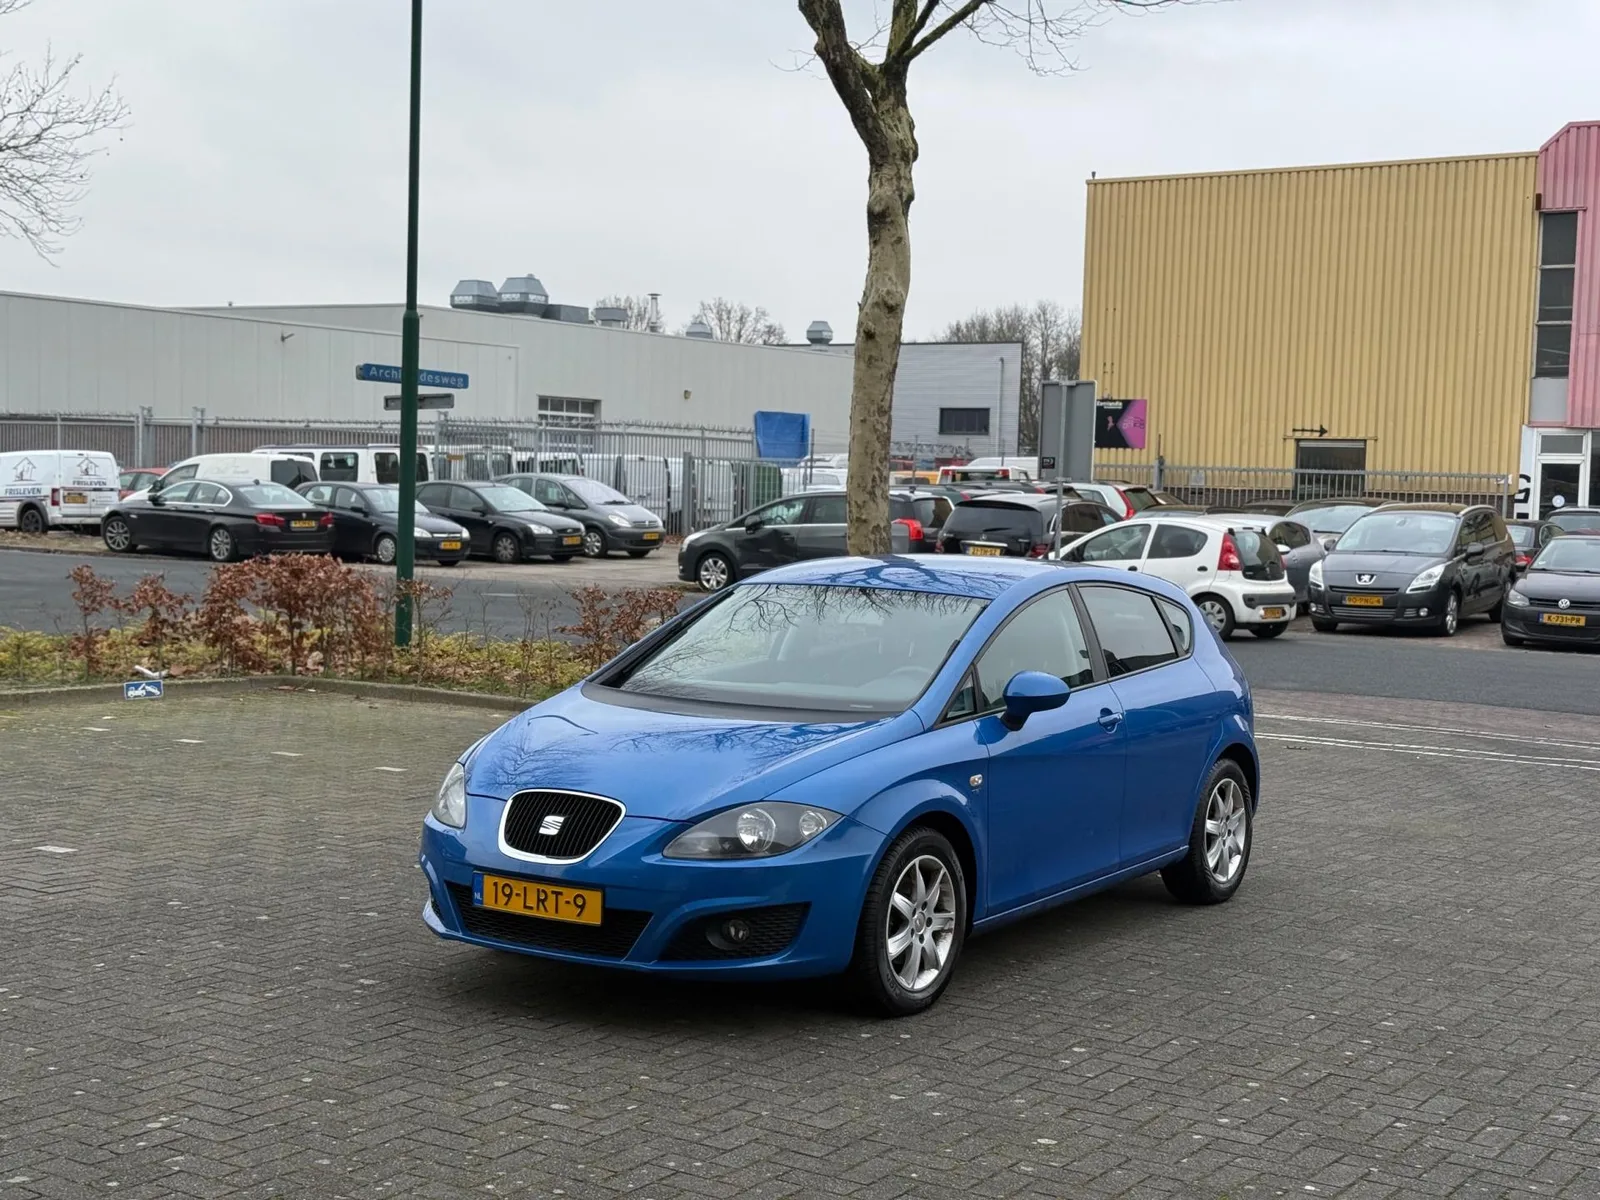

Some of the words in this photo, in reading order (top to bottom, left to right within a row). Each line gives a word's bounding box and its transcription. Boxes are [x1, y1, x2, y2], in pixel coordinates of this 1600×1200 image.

[369, 366, 464, 387] Archidesweg
[4, 487, 42, 496] FRISLEVEN
[1547, 614, 1581, 624] K-731-PR
[474, 891, 483, 901] NL
[492, 881, 587, 917] 19-LRT-9
